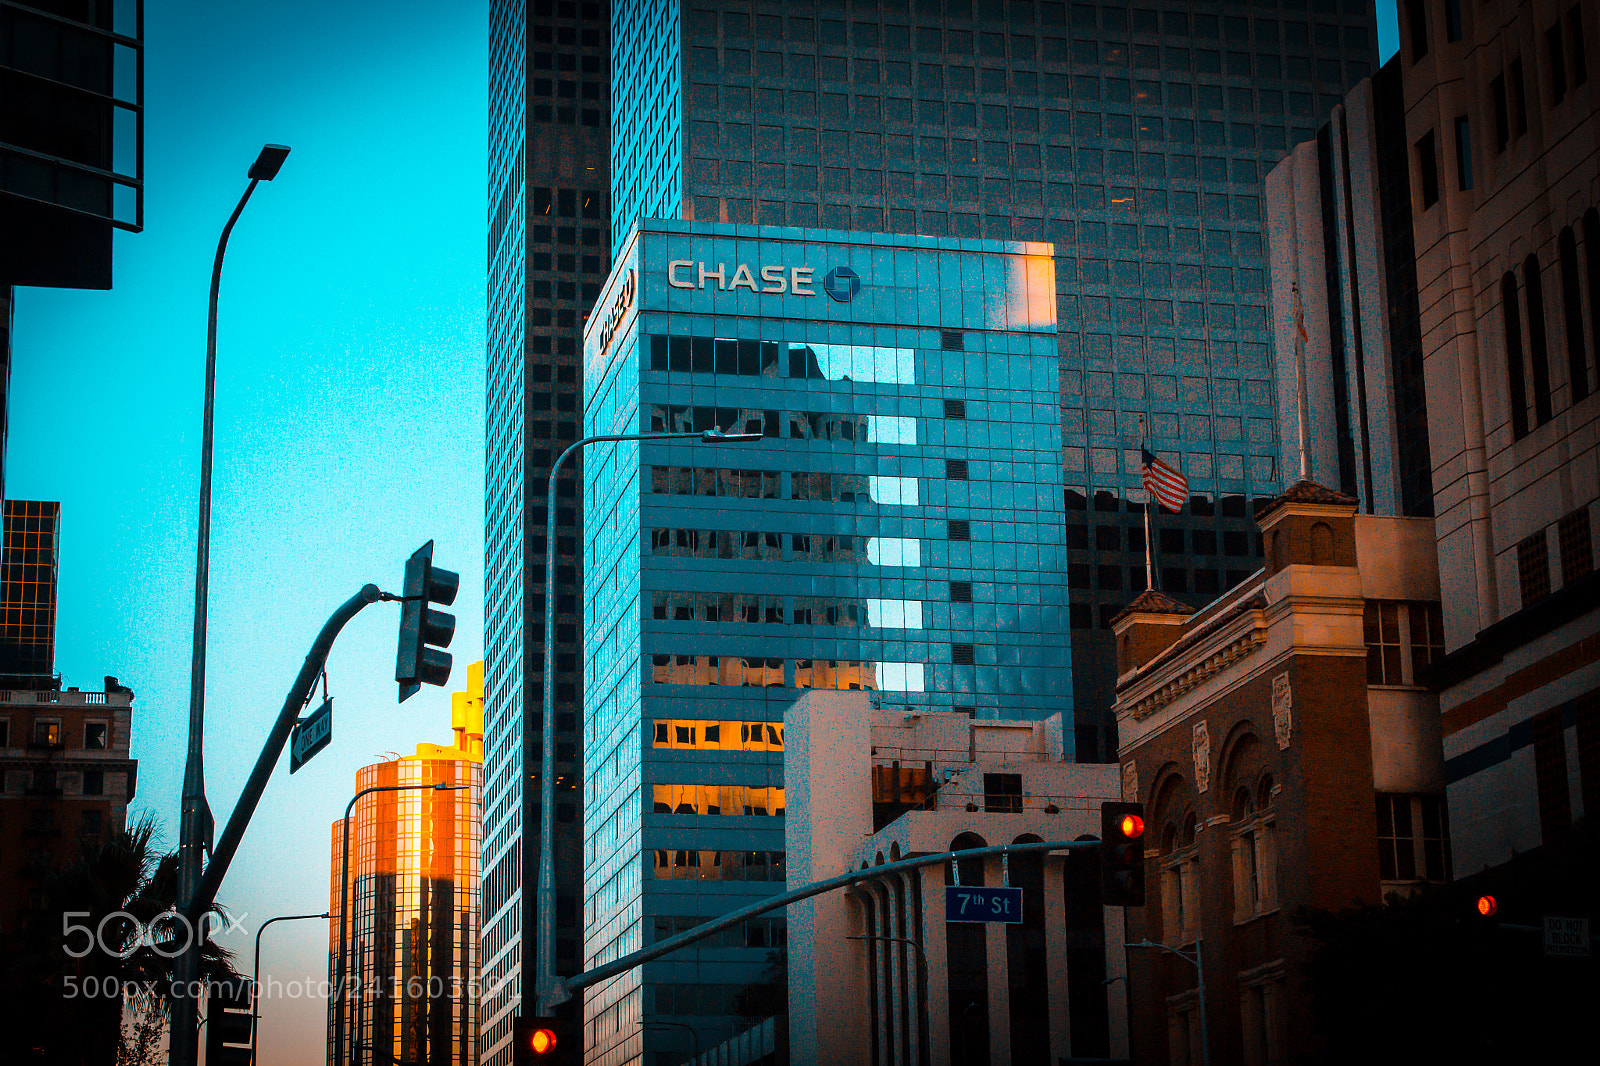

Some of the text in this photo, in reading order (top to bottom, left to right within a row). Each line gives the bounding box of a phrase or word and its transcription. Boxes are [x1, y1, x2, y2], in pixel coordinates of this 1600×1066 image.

[668, 260, 816, 296] CHASE
[957, 893, 1011, 915] 7th St
[1549, 919, 1583, 932] DO NOT
[1552, 932, 1582, 945] BLOCK
